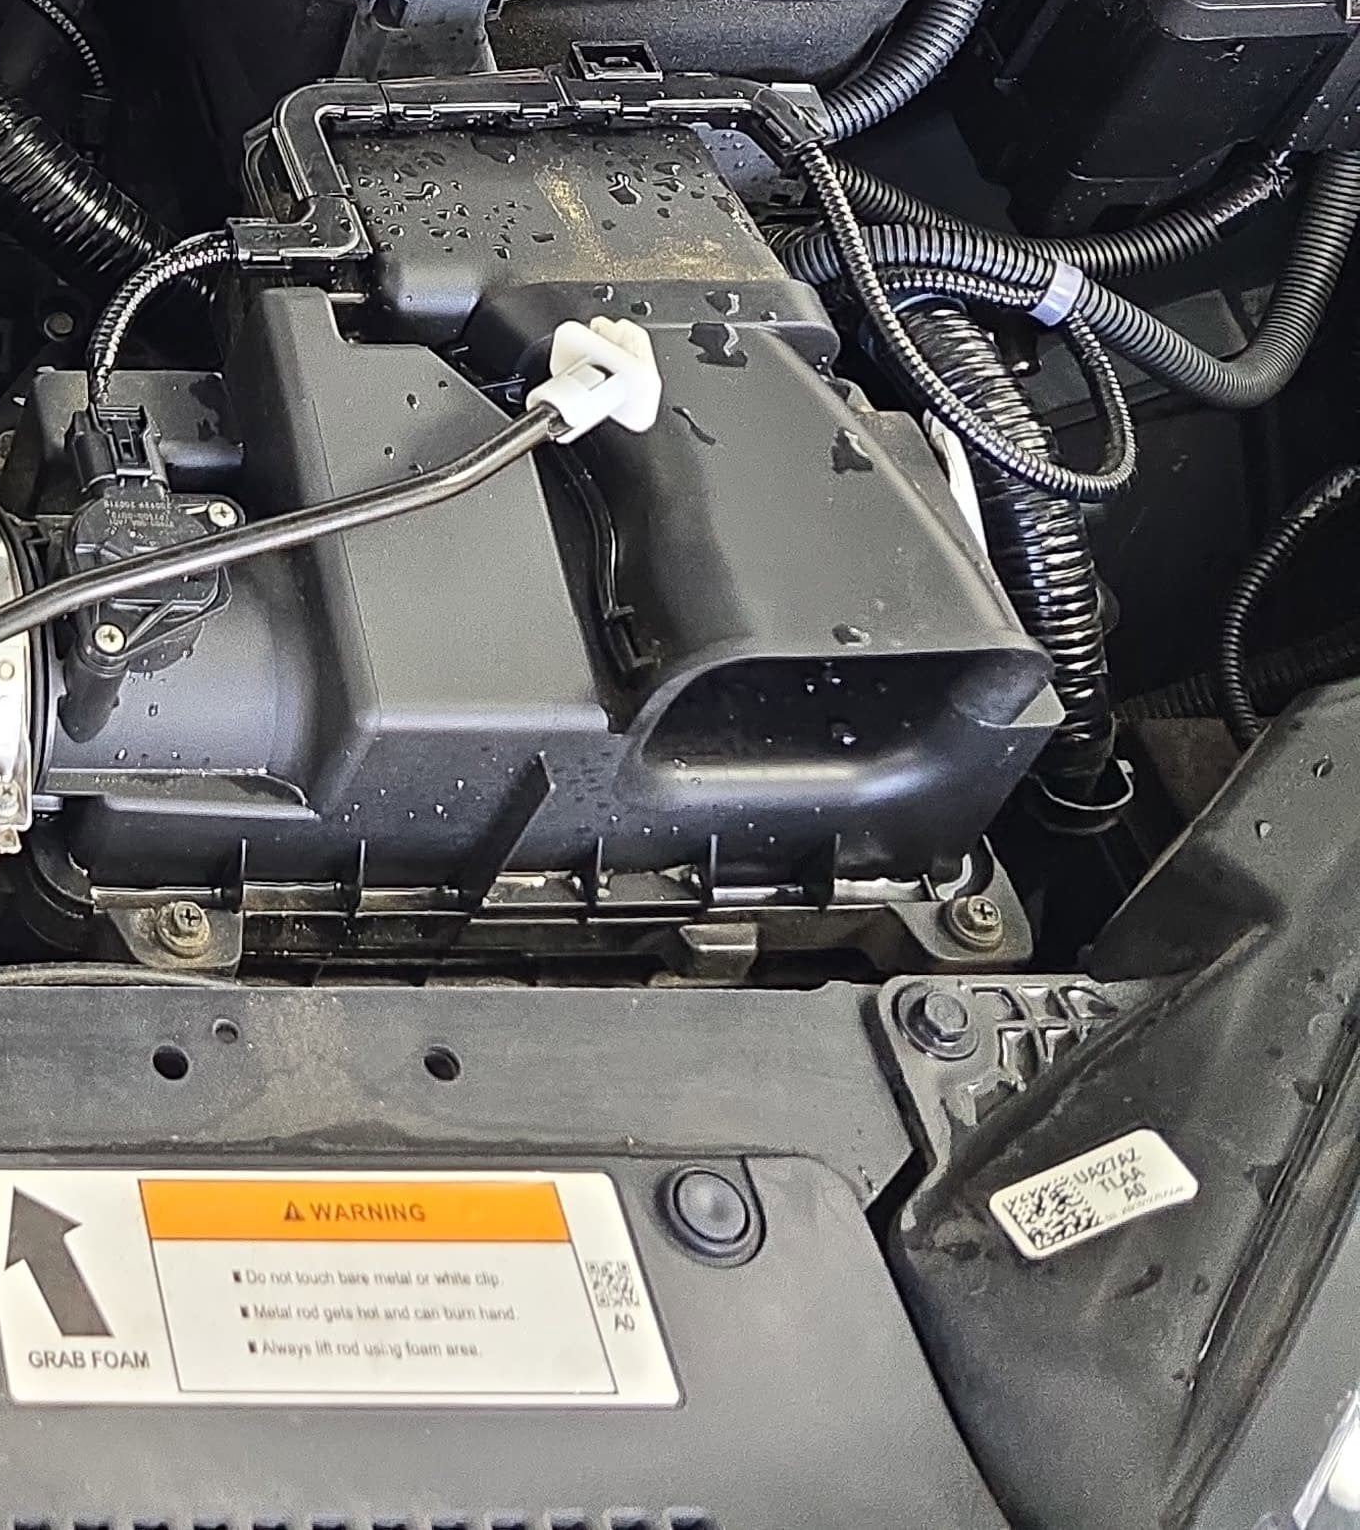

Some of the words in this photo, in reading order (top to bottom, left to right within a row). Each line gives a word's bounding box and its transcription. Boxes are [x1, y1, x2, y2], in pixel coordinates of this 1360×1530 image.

[1096, 1167, 1146, 1194] TLAA
[311, 1201, 426, 1224] WARNING
[246, 1269, 266, 1285] Do
[271, 1270, 292, 1284] not
[296, 1270, 335, 1285] touch
[338, 1270, 369, 1285] bare
[374, 1270, 412, 1285] metal
[417, 1272, 430, 1285] or
[434, 1270, 471, 1285] white
[254, 1305, 292, 1319] Metal
[297, 1306, 319, 1319] rod
[324, 1307, 353, 1322] gets
[357, 1306, 380, 1319] hot
[385, 1306, 410, 1320] and
[414, 1308, 439, 1320] can
[444, 1306, 476, 1320] burn
[262, 1341, 312, 1358] Always
[316, 1341, 333, 1355] lift
[338, 1341, 360, 1356] rod
[364, 1343, 402, 1359] using
[406, 1341, 441, 1356] foam
[29, 1350, 87, 1369] GRAB
[92, 1350, 150, 1369] FOAM
